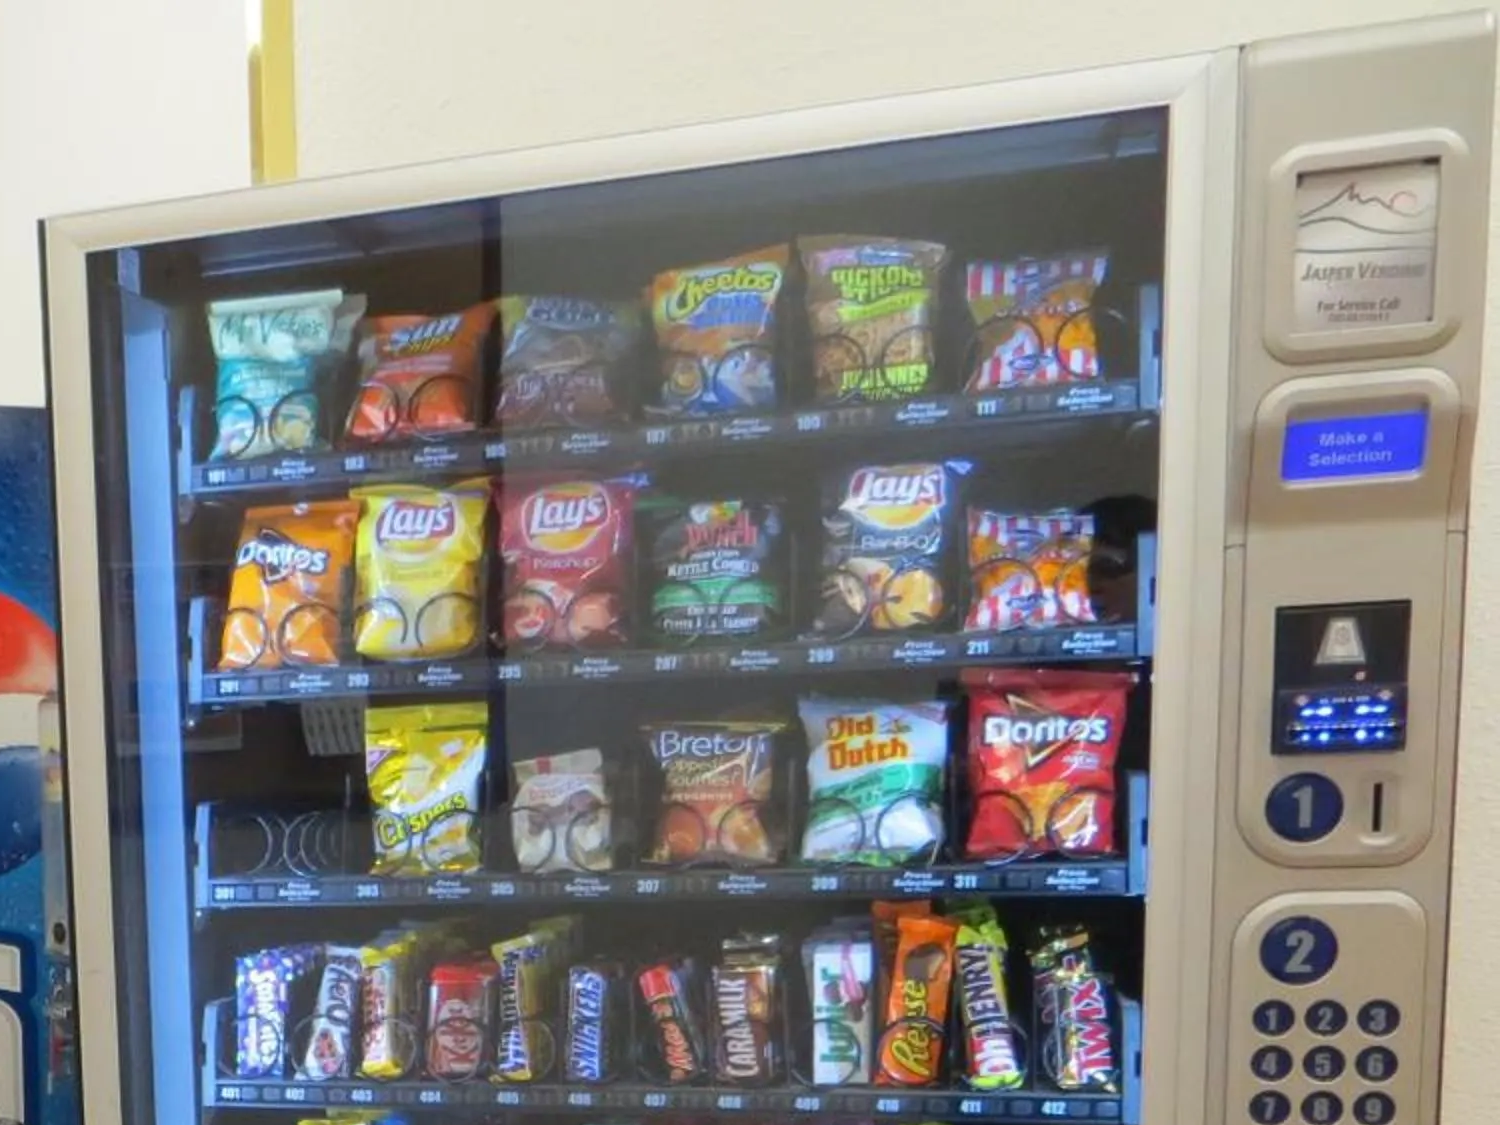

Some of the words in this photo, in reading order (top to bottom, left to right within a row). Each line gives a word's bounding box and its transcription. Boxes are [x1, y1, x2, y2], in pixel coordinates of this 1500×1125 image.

[1301, 264, 1355, 283] JASPER
[666, 267, 777, 320] Cheetos
[1317, 300, 1335, 313] For
[1338, 298, 1377, 312] Service
[977, 399, 996, 416] 111
[1319, 432, 1368, 448] Make
[1308, 449, 1394, 468] Selection
[236, 542, 329, 575] Doritos
[966, 640, 990, 656] 211
[826, 713, 876, 742] Old
[984, 716, 1111, 745] Doritos
[660, 729, 766, 759] Breton
[828, 737, 909, 771] Dutch
[1291, 784, 1314, 830] 1
[954, 873, 978, 889] 311
[1284, 928, 1315, 974] 2
[569, 969, 602, 1080] SNICKERS
[718, 977, 760, 1079] CARAMILK
[891, 978, 932, 1077] Reese
[1265, 1007, 1278, 1031] 1
[1317, 1007, 1333, 1032] 2
[1369, 1008, 1387, 1032] 3
[1261, 1052, 1277, 1076] 4
[1314, 1053, 1331, 1077] 5
[1367, 1053, 1384, 1077] 6
[220, 1087, 240, 1100] 401
[351, 1088, 373, 1102] 403
[960, 1100, 982, 1115] 411
[1041, 1100, 1067, 1116] 412
[1261, 1098, 1276, 1121] 7
[1313, 1098, 1329, 1122] 8
[1364, 1098, 1382, 1122] 9
